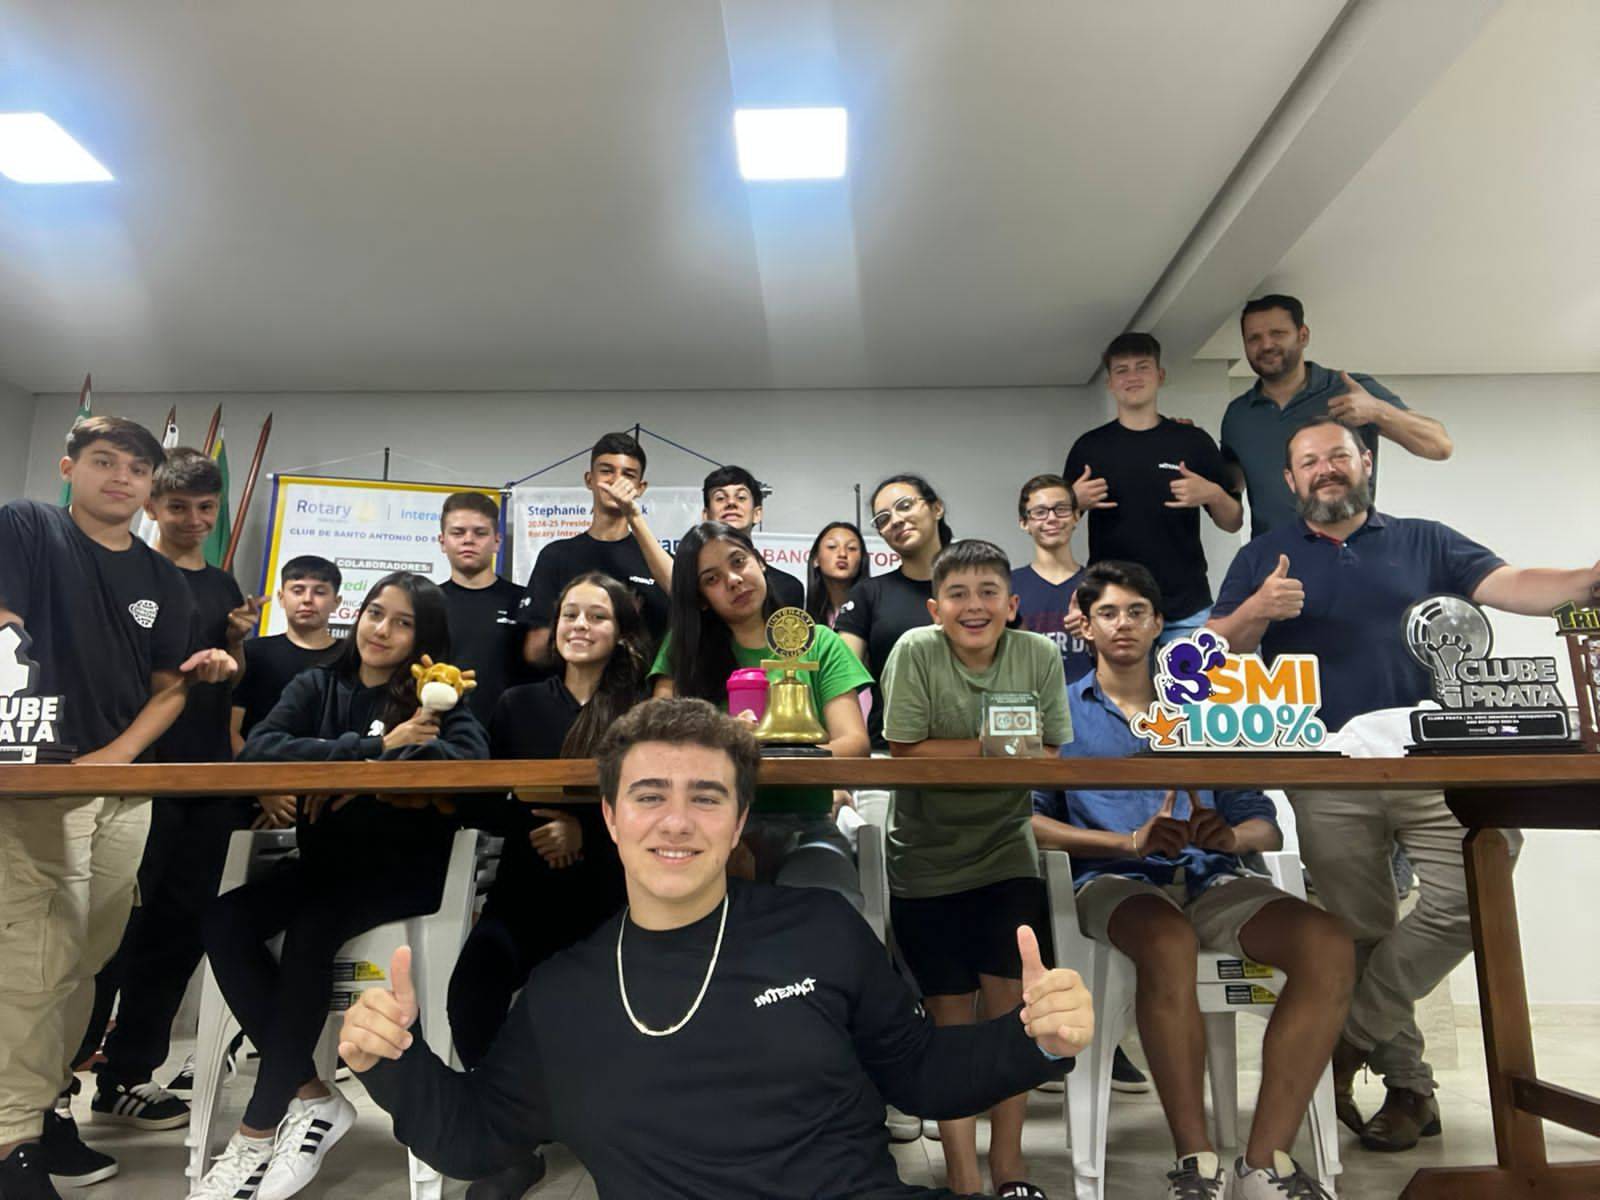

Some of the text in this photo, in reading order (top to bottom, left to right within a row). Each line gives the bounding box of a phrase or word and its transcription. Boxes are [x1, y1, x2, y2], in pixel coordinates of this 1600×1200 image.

[296, 500, 352, 518] Rotary
[401, 509, 441, 521] Intera
[528, 505, 586, 517] Stephanie
[561, 520, 592, 528] Preside
[289, 527, 315, 536] CLUB
[318, 529, 331, 537] DE
[334, 530, 366, 539] SANTO
[369, 533, 412, 542] ANTONIO
[415, 535, 429, 543] DO
[763, 548, 809, 563] BANC
[343, 580, 368, 591] edi
[1457, 659, 1557, 682] CLUBE
[1207, 658, 1317, 704] SMI
[1463, 684, 1563, 708] PRATA
[0, 696, 58, 721] UBE
[0, 720, 55, 743] ATA
[1182, 703, 1323, 744] 100%
[754, 977, 816, 1008] INTERACT
